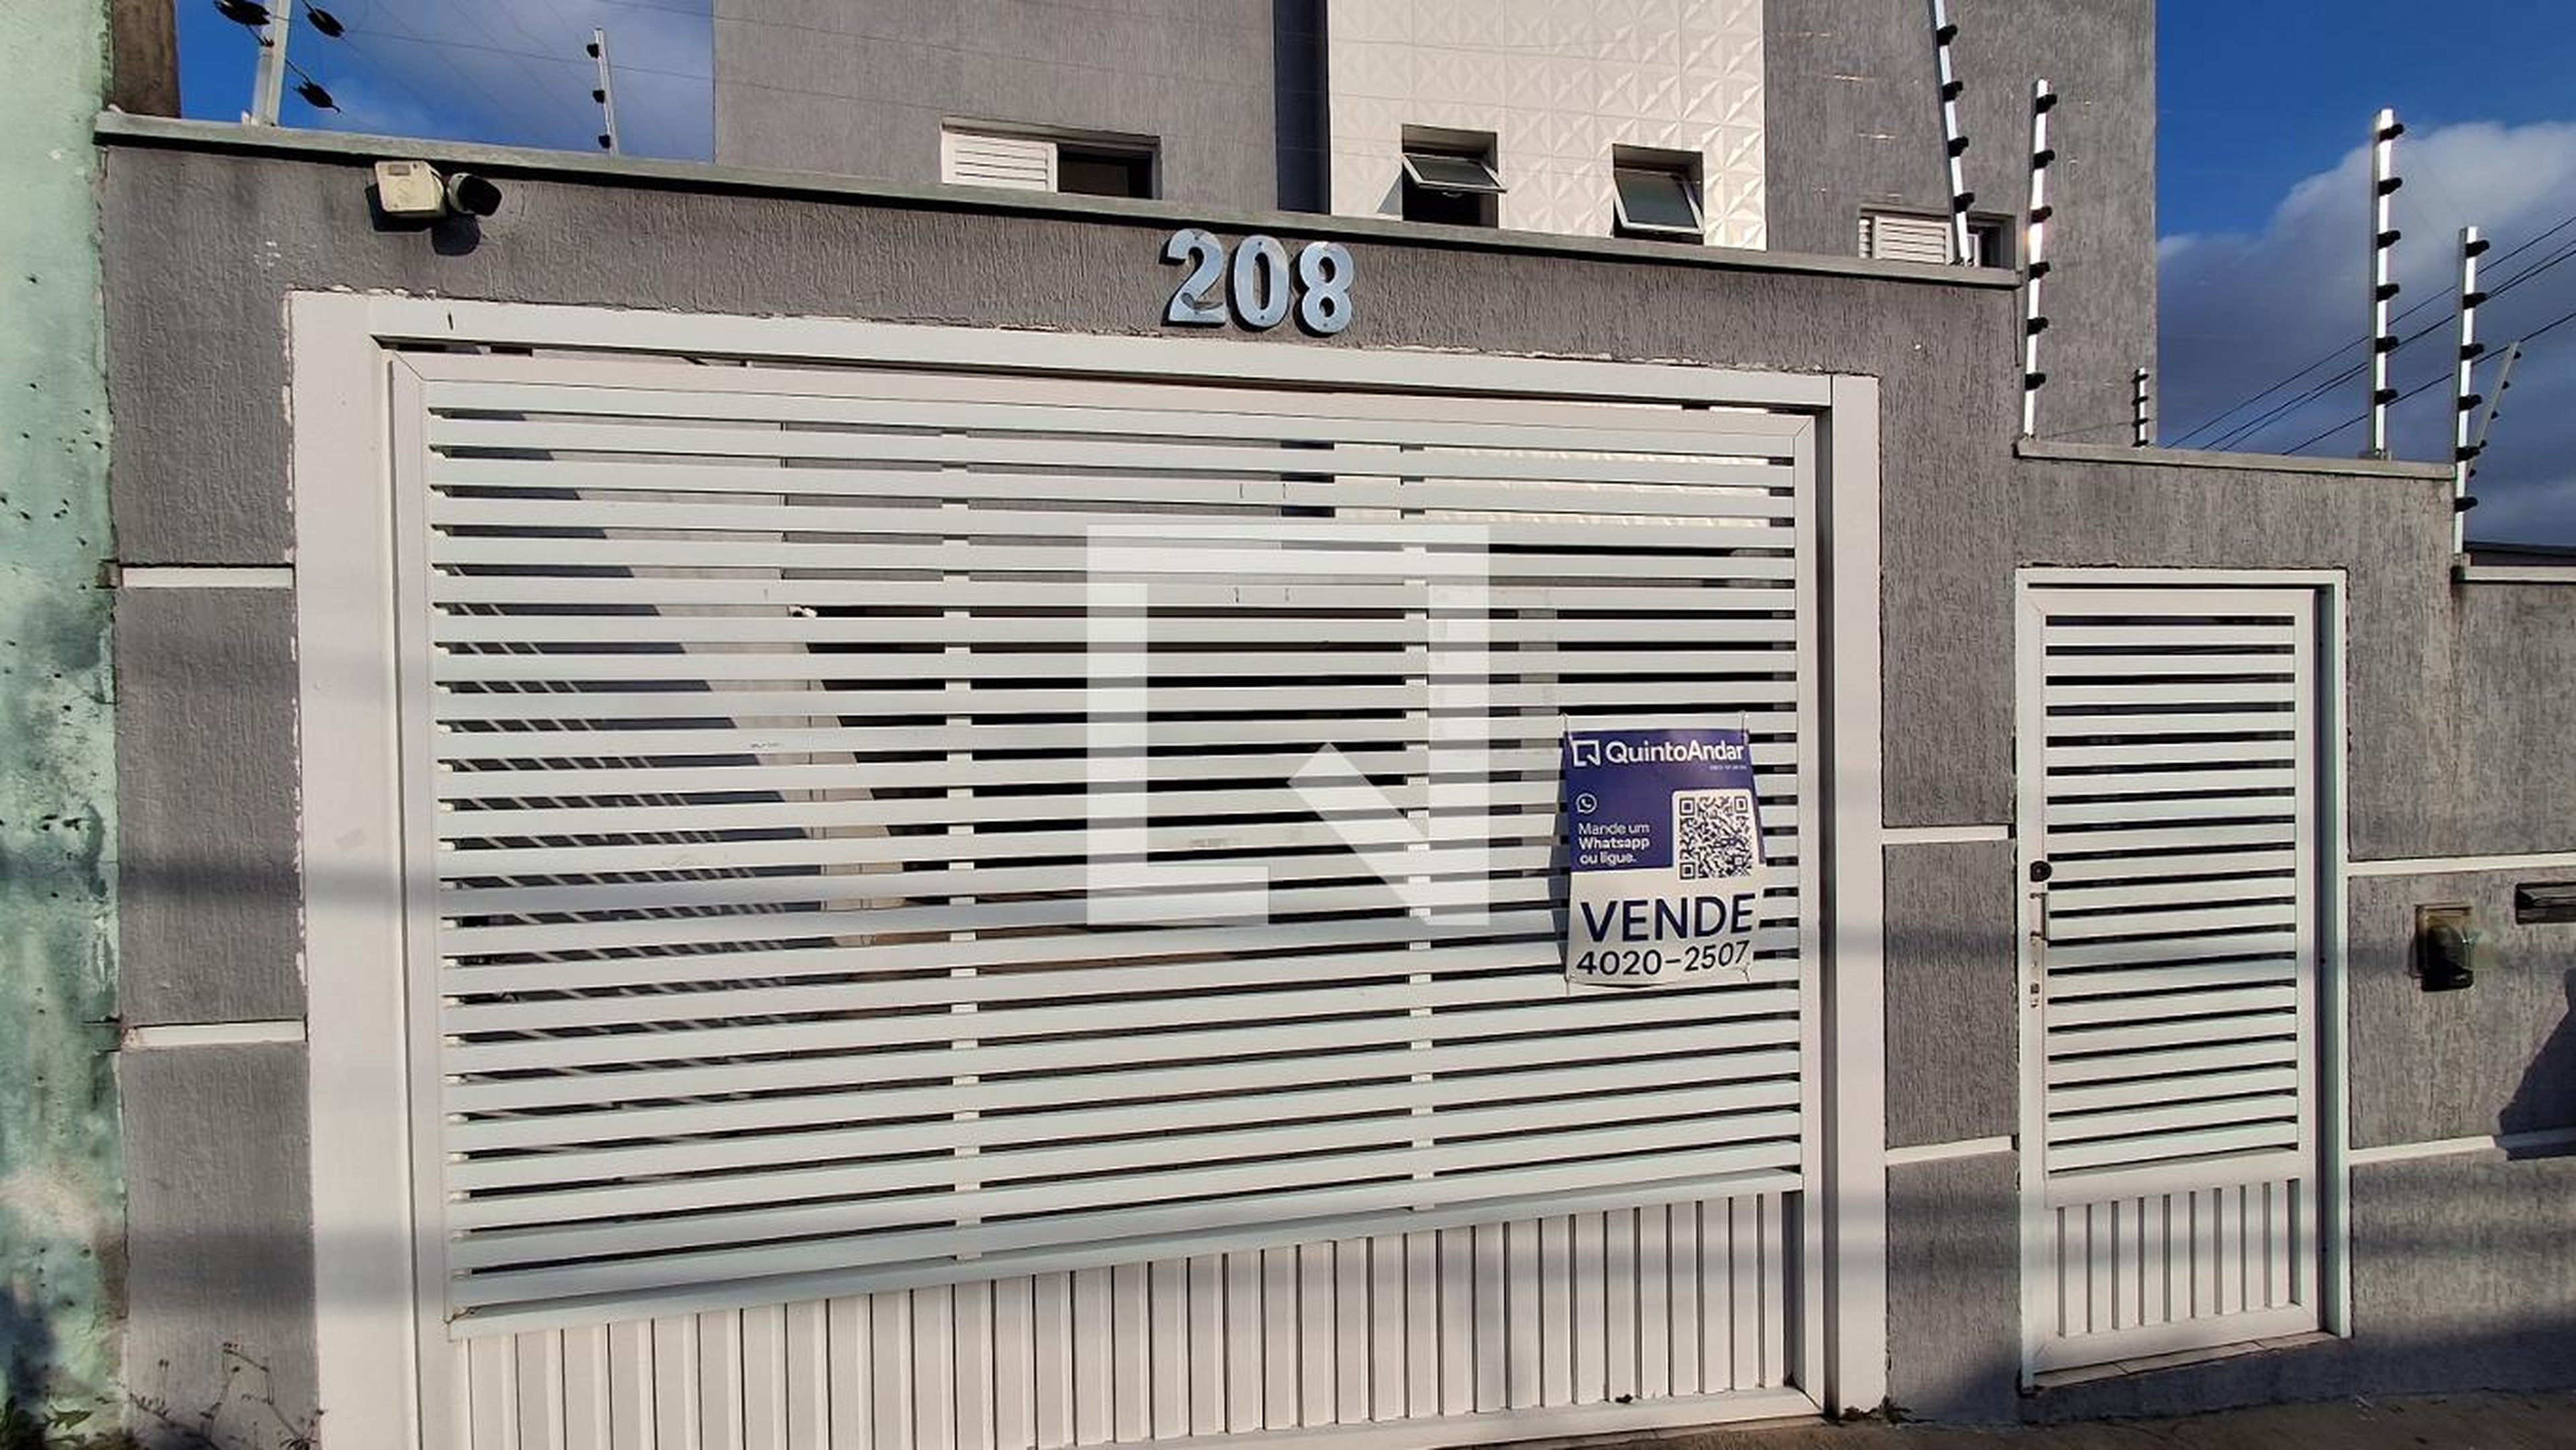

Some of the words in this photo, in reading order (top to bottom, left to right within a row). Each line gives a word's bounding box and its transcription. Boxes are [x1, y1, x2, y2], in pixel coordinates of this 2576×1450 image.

[1161, 228, 1354, 336] 208
[1605, 740, 1743, 764] QuintoAndar
[1578, 823, 1626, 835] Mande
[1628, 825, 1650, 834] um
[1578, 837, 1650, 850] Whatsapp
[1580, 854, 1599, 864] ou
[1600, 851, 1637, 866] ligue.
[1580, 893, 1756, 943] VENDE
[1576, 940, 1750, 975] 4020-2507
